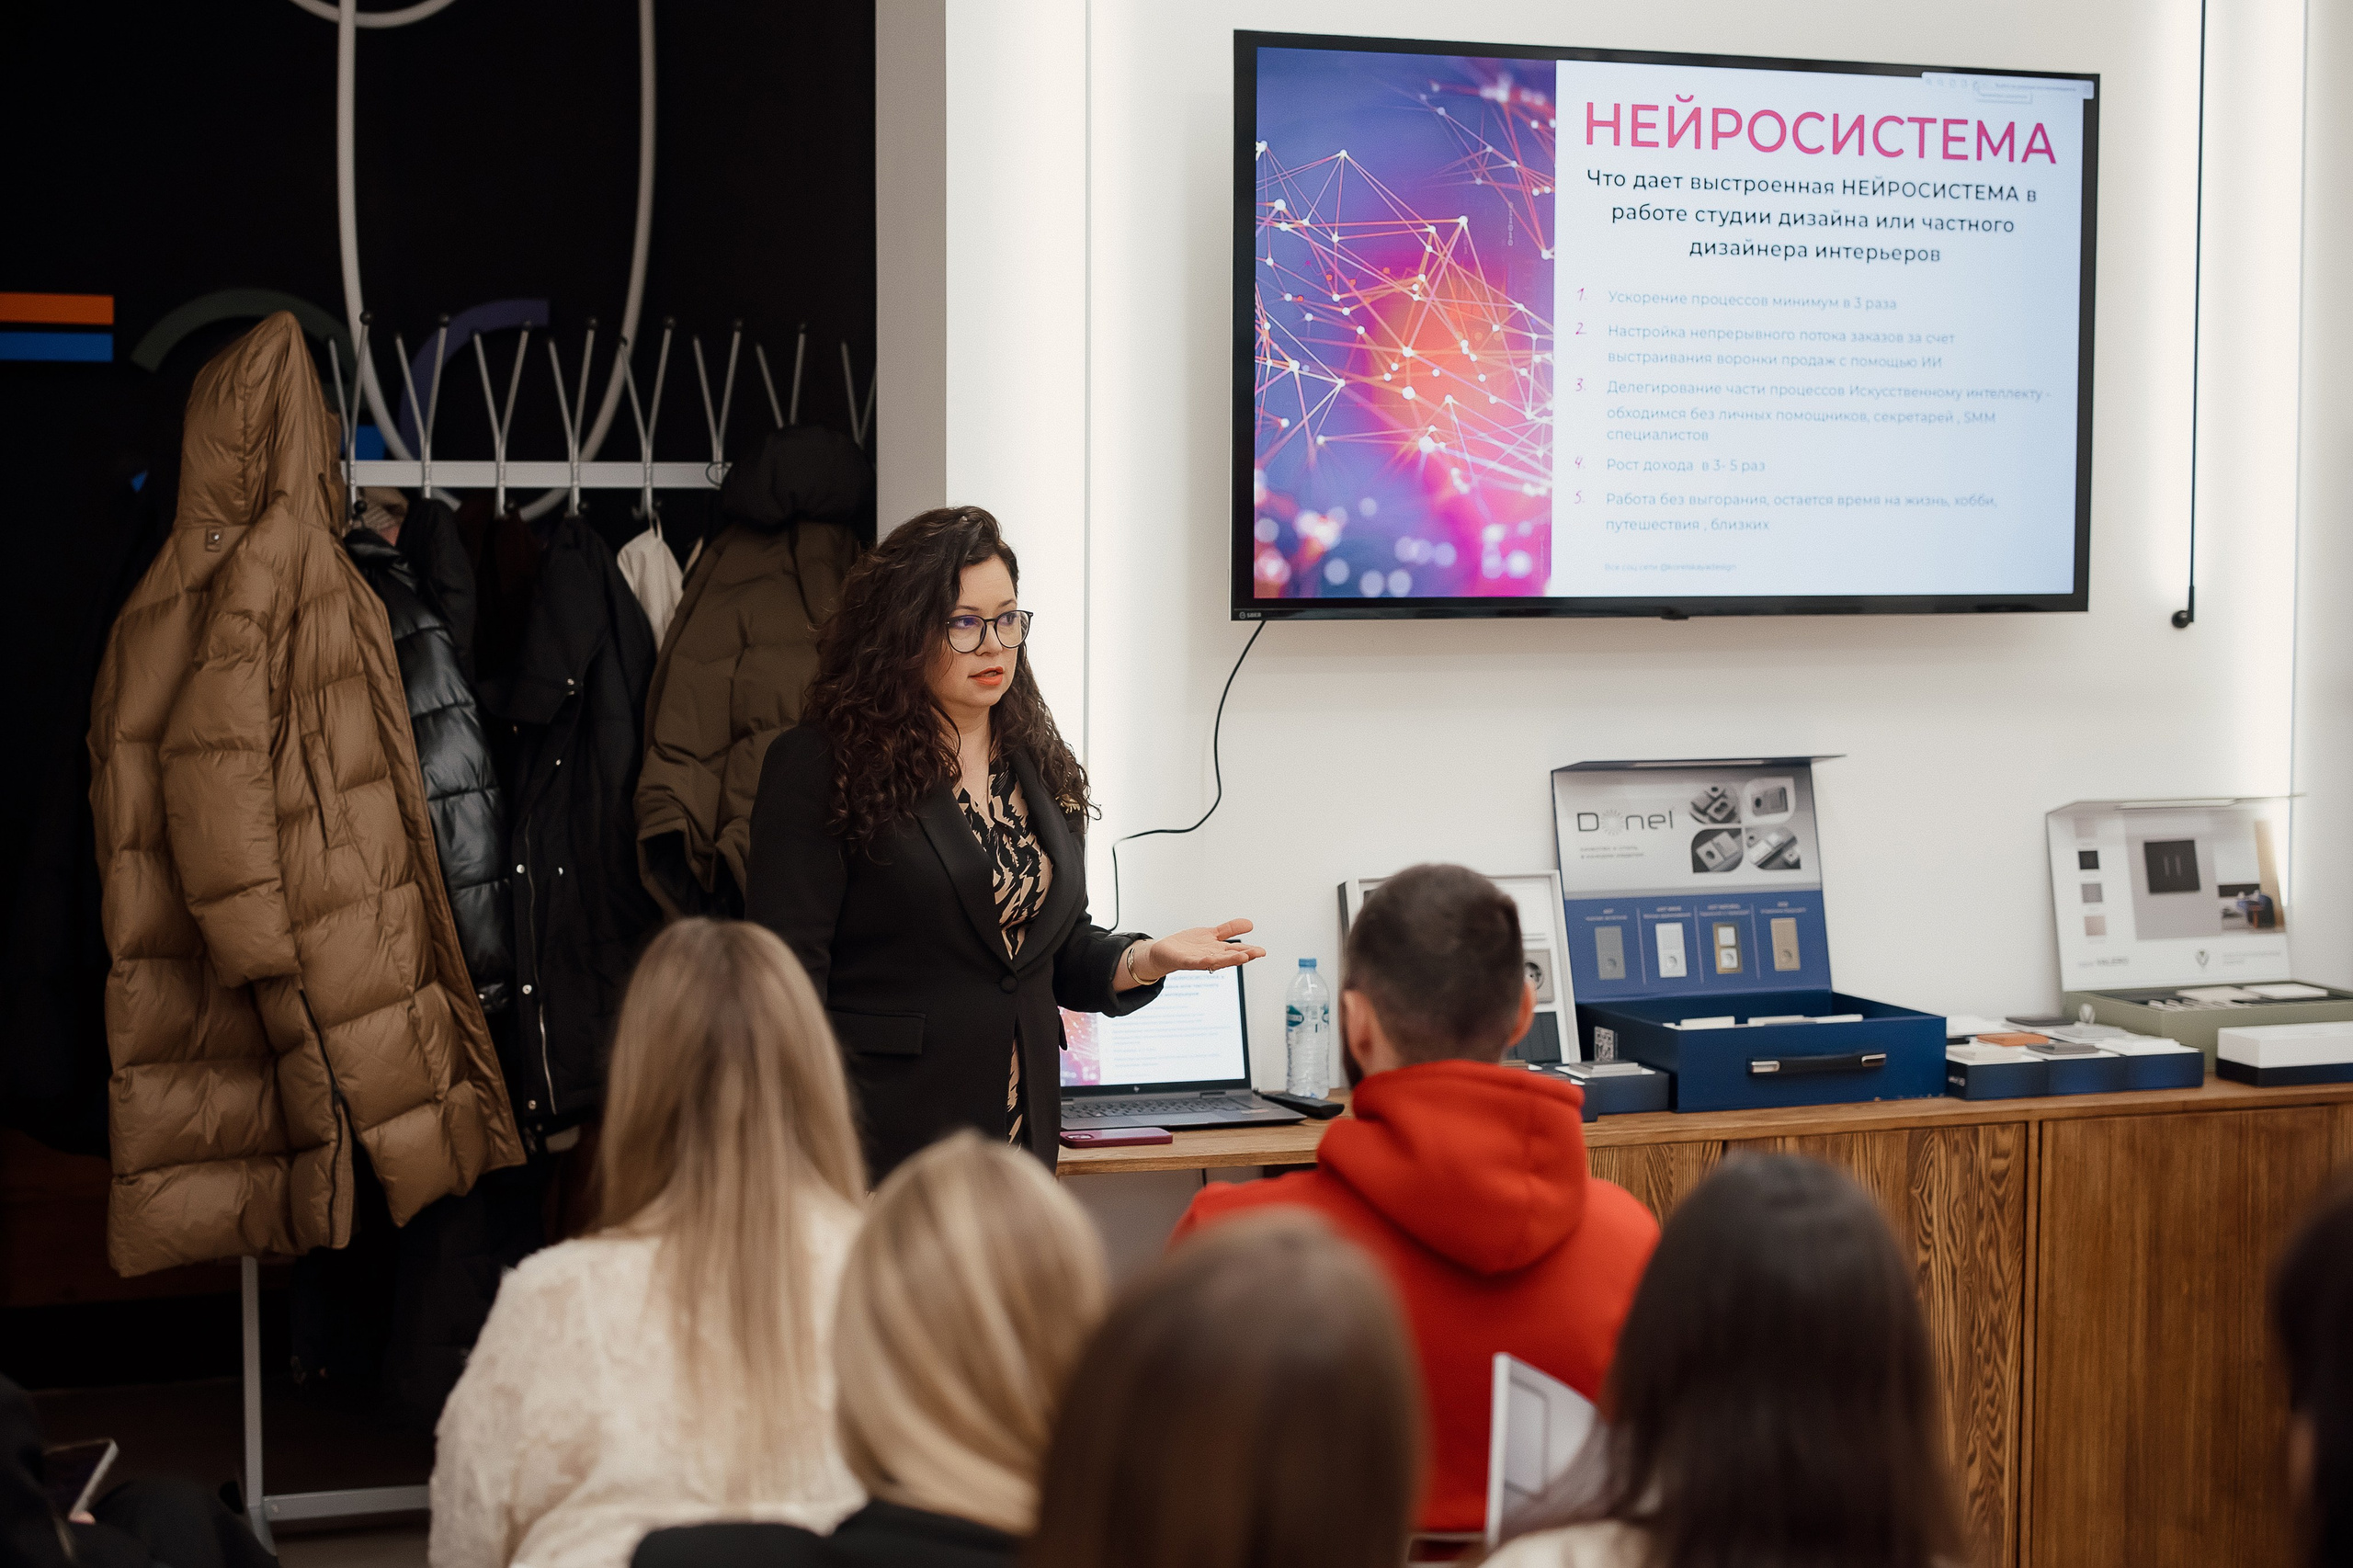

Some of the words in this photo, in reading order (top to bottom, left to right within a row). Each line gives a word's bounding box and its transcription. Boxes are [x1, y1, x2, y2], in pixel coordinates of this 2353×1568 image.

[1586, 94, 2057, 165] НЕЙРОСИСТЕМА
[1586, 168, 1626, 187] Что
[1632, 175, 1684, 190] дает
[1690, 176, 1835, 196] выстроенная
[1842, 175, 2019, 202] НЕЙРОСИСТЕМА
[2027, 189, 2037, 202] в
[1611, 202, 1688, 224] работе
[1695, 209, 1771, 228] студии
[1778, 210, 1870, 229] дизайна
[1876, 216, 1915, 229] или
[1921, 217, 2015, 233] частного
[1688, 239, 1808, 260] дизайнера
[1815, 245, 1940, 266] интерьеров
[1608, 290, 1688, 306] Ускорение
[1691, 294, 1769, 307] процессов
[1772, 297, 1839, 311] минимум
[1842, 299, 1851, 309] в
[1854, 296, 1862, 310] 3
[1865, 299, 1898, 312] раза
[1608, 324, 1687, 340] Настройка
[1689, 328, 1796, 342] непрерывного
[1799, 330, 1847, 343] потока
[1851, 332, 1904, 344] заказов
[1908, 333, 1923, 344] за
[1926, 333, 1956, 345] счет
[1608, 352, 1712, 365] выстраивания
[1716, 355, 1778, 367] воронки
[1781, 356, 1836, 368] продаж
[1838, 356, 1847, 368] с
[1850, 357, 1918, 369] помощью
[1921, 357, 1942, 369] ИИ
[1607, 380, 1722, 396] Делегирование
[1725, 384, 1766, 395] части
[1769, 385, 1846, 398] процессов
[1848, 384, 1963, 403] Искусственному
[1966, 388, 2044, 403] интеллекту
[1607, 405, 1687, 421] обходимся
[1689, 406, 1715, 420] без
[1719, 410, 1772, 421] личных
[1776, 411, 1870, 423] помощников,
[1873, 409, 1955, 426] секретарей
[1963, 412, 1996, 424] SMM
[1606, 430, 1710, 442] специалистов
[1607, 458, 1640, 472] Рост
[1643, 460, 1694, 472] дохода
[1701, 460, 1711, 472] в
[1730, 459, 1738, 472] 5
[1741, 461, 1766, 473] раз
[1606, 492, 1656, 506] Работа
[1659, 493, 1685, 506] без
[1688, 495, 1770, 507] выгорания,
[1773, 495, 1835, 506] остается
[1836, 495, 1881, 508] время
[1884, 495, 1902, 506] на
[1606, 520, 1700, 533] путешествия
[1711, 517, 1769, 530] близких
